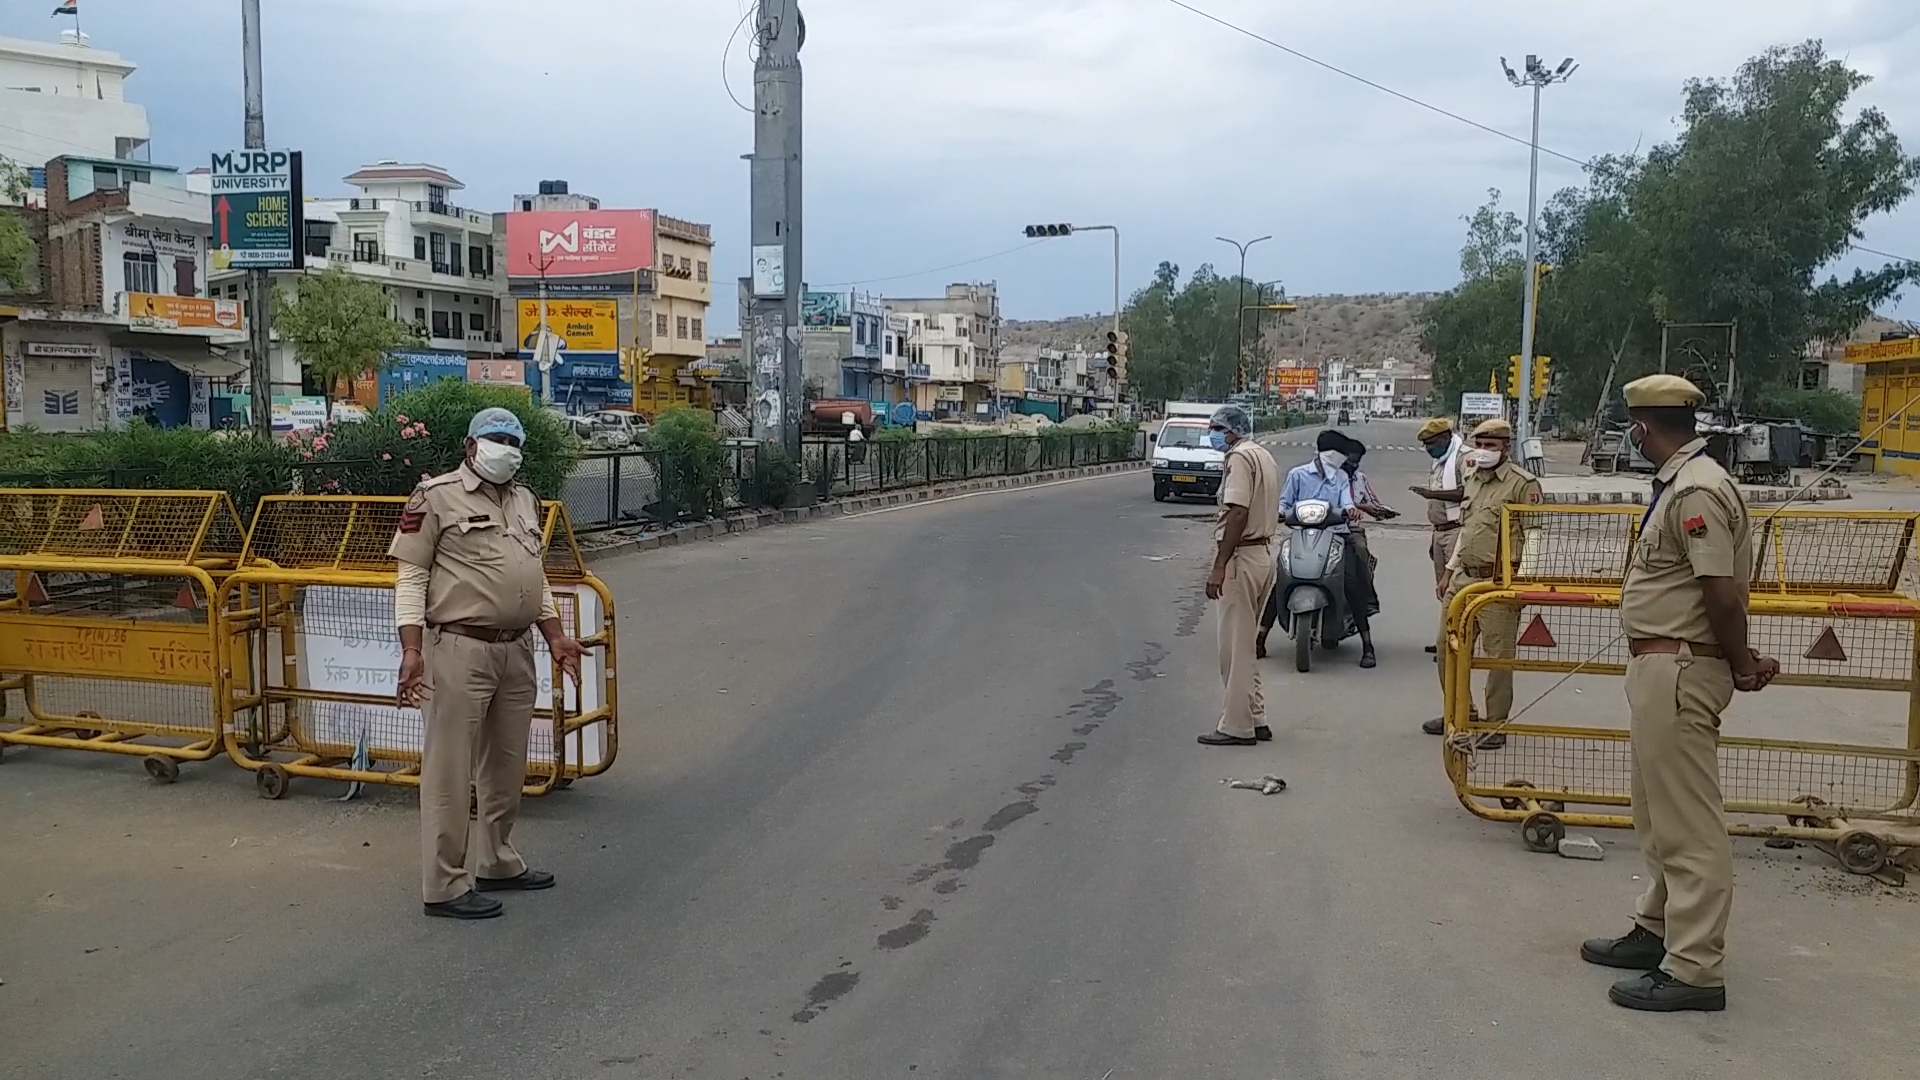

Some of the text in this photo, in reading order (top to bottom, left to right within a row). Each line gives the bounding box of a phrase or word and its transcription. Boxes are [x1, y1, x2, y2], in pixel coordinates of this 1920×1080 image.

[211, 151, 287, 174] MJRP
[212, 178, 287, 189] UNIVERSITY
[257, 196, 288, 211] HOME
[246, 212, 288, 227] SCIENCE
[124, 222, 150, 240] बीमा
[152, 227, 172, 243] सेवा
[174, 229, 196, 249] केन्द्र
[582, 224, 616, 239] वंडर
[582, 240, 616, 252] सीमेंट
[566, 323, 593, 331] Ambuja
[23, 638, 124, 665] राजस्थान
